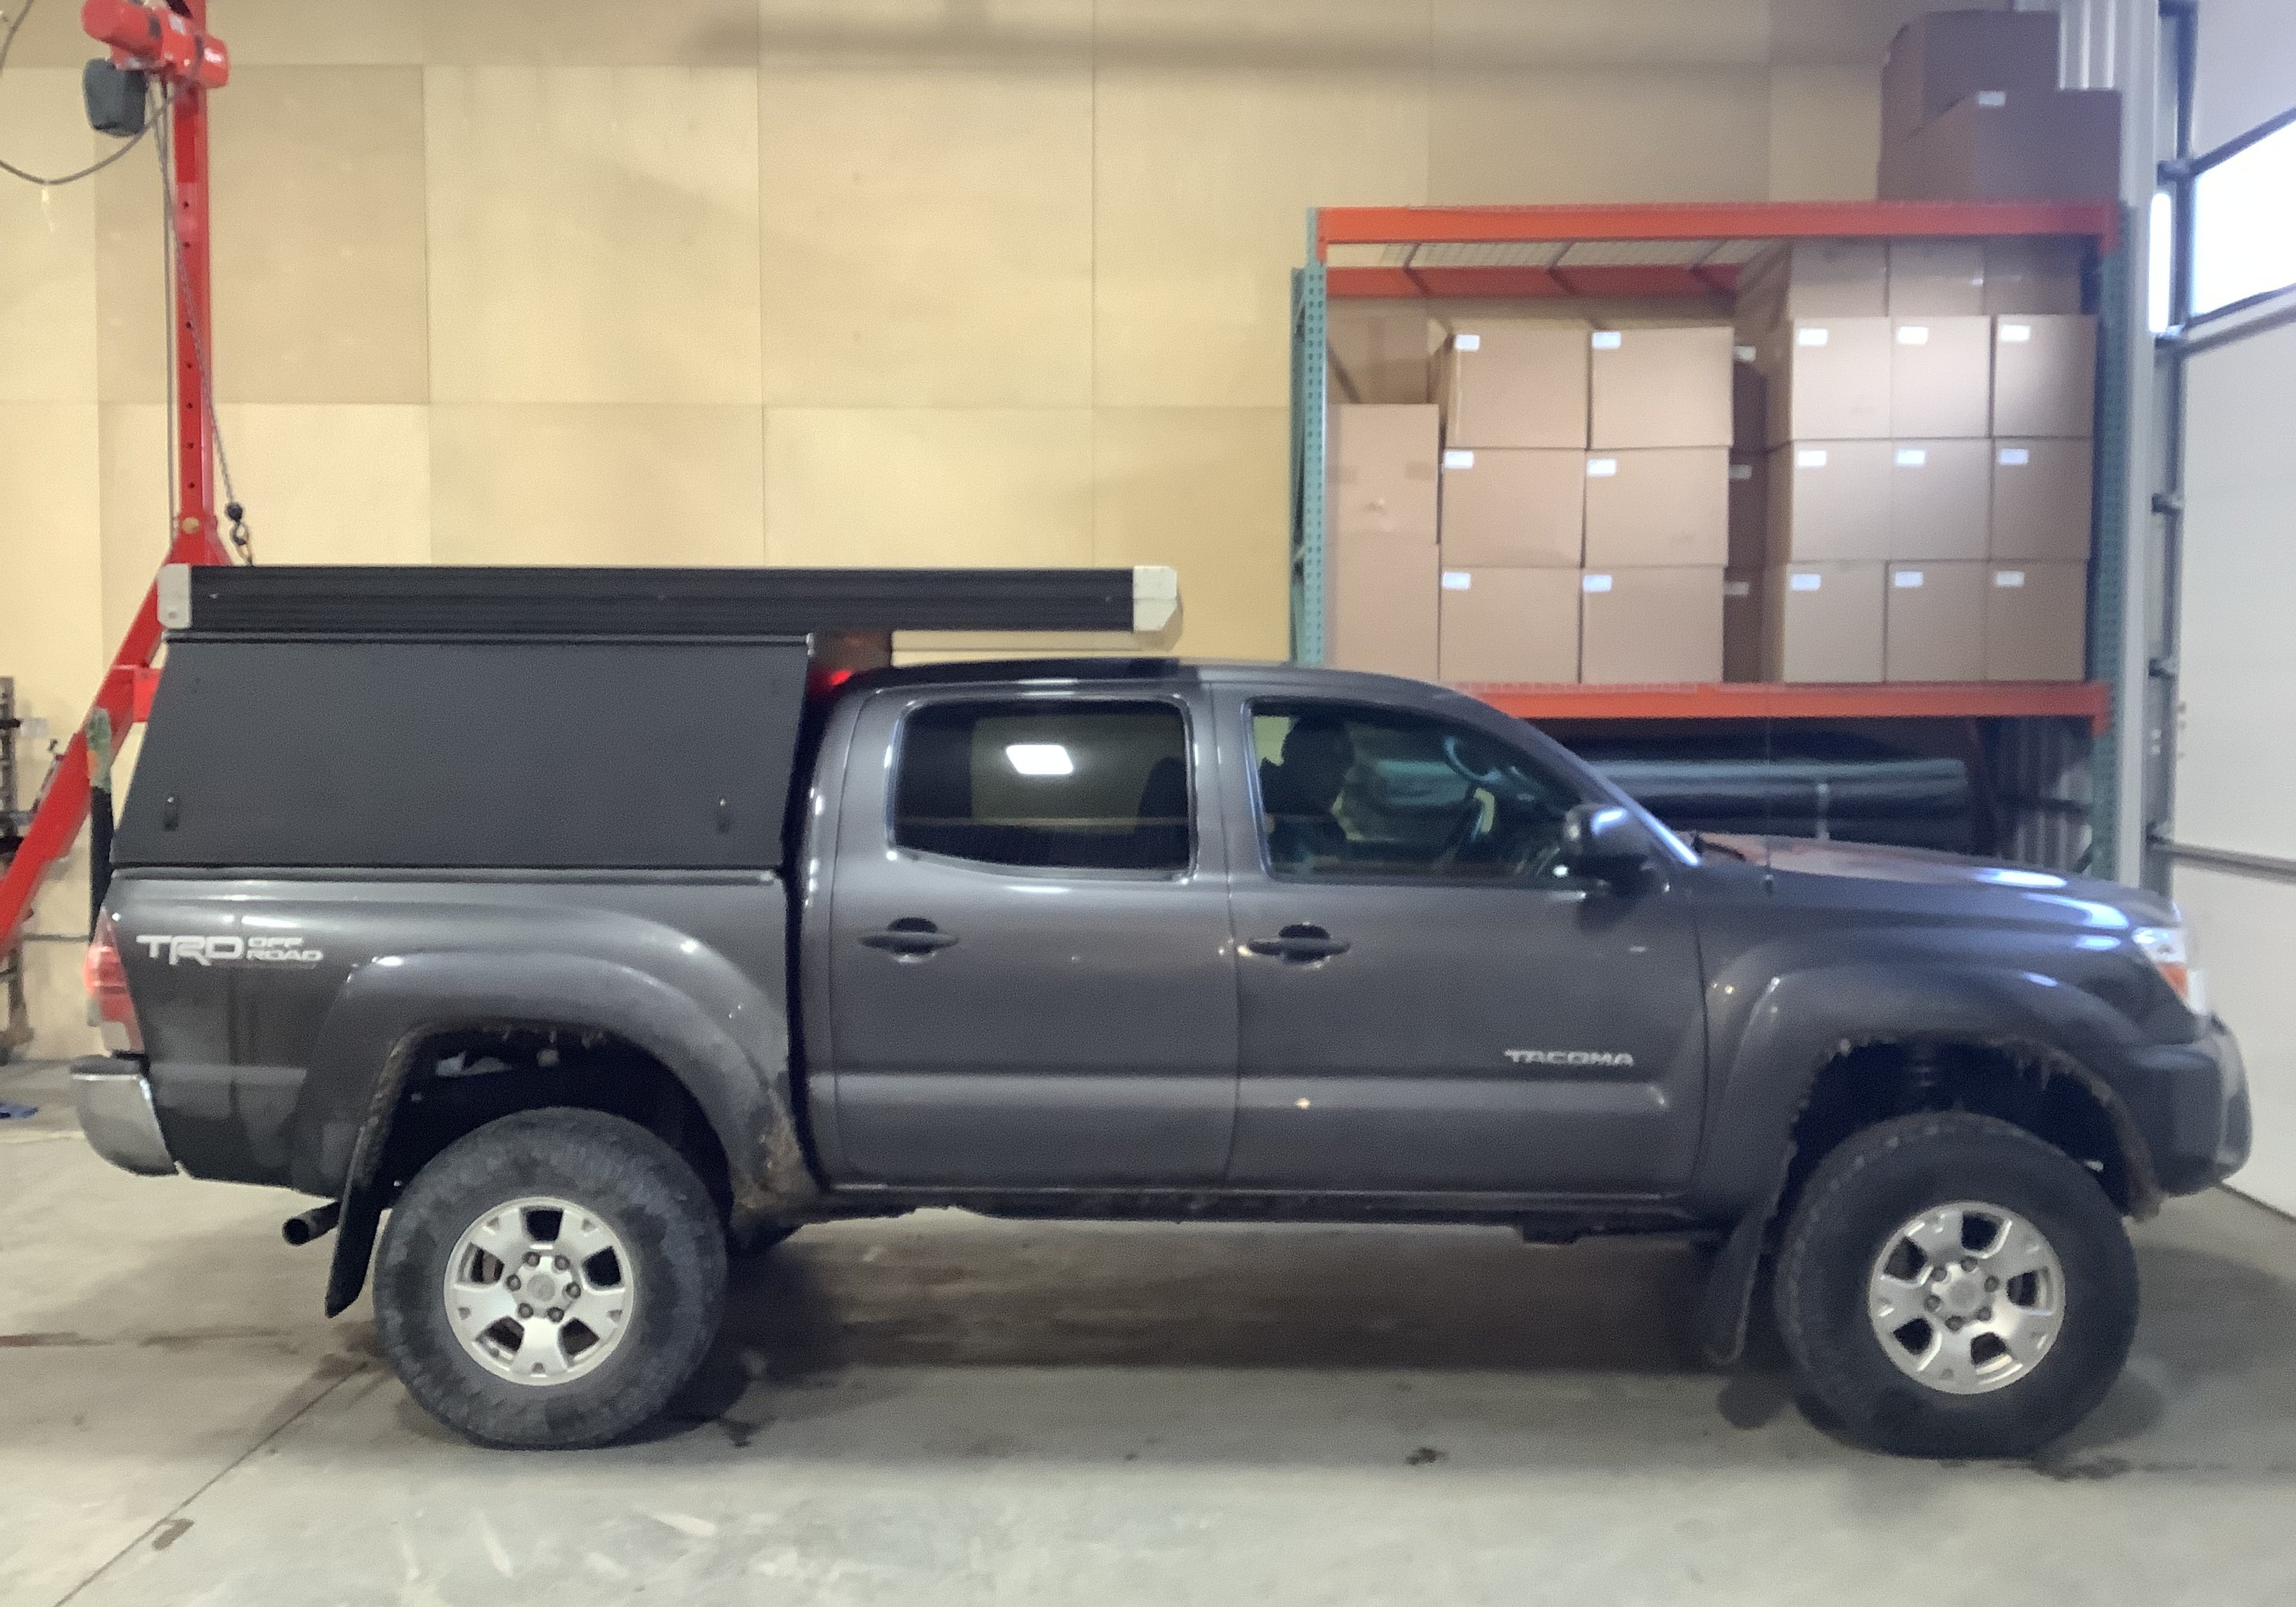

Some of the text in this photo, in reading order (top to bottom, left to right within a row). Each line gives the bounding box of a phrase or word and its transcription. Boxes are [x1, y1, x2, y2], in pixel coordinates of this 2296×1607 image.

[247, 936, 303, 948] OFF
[136, 935, 244, 966] TRD
[247, 950, 324, 961] ROAD
[1505, 1050, 1633, 1067] TACOMA
